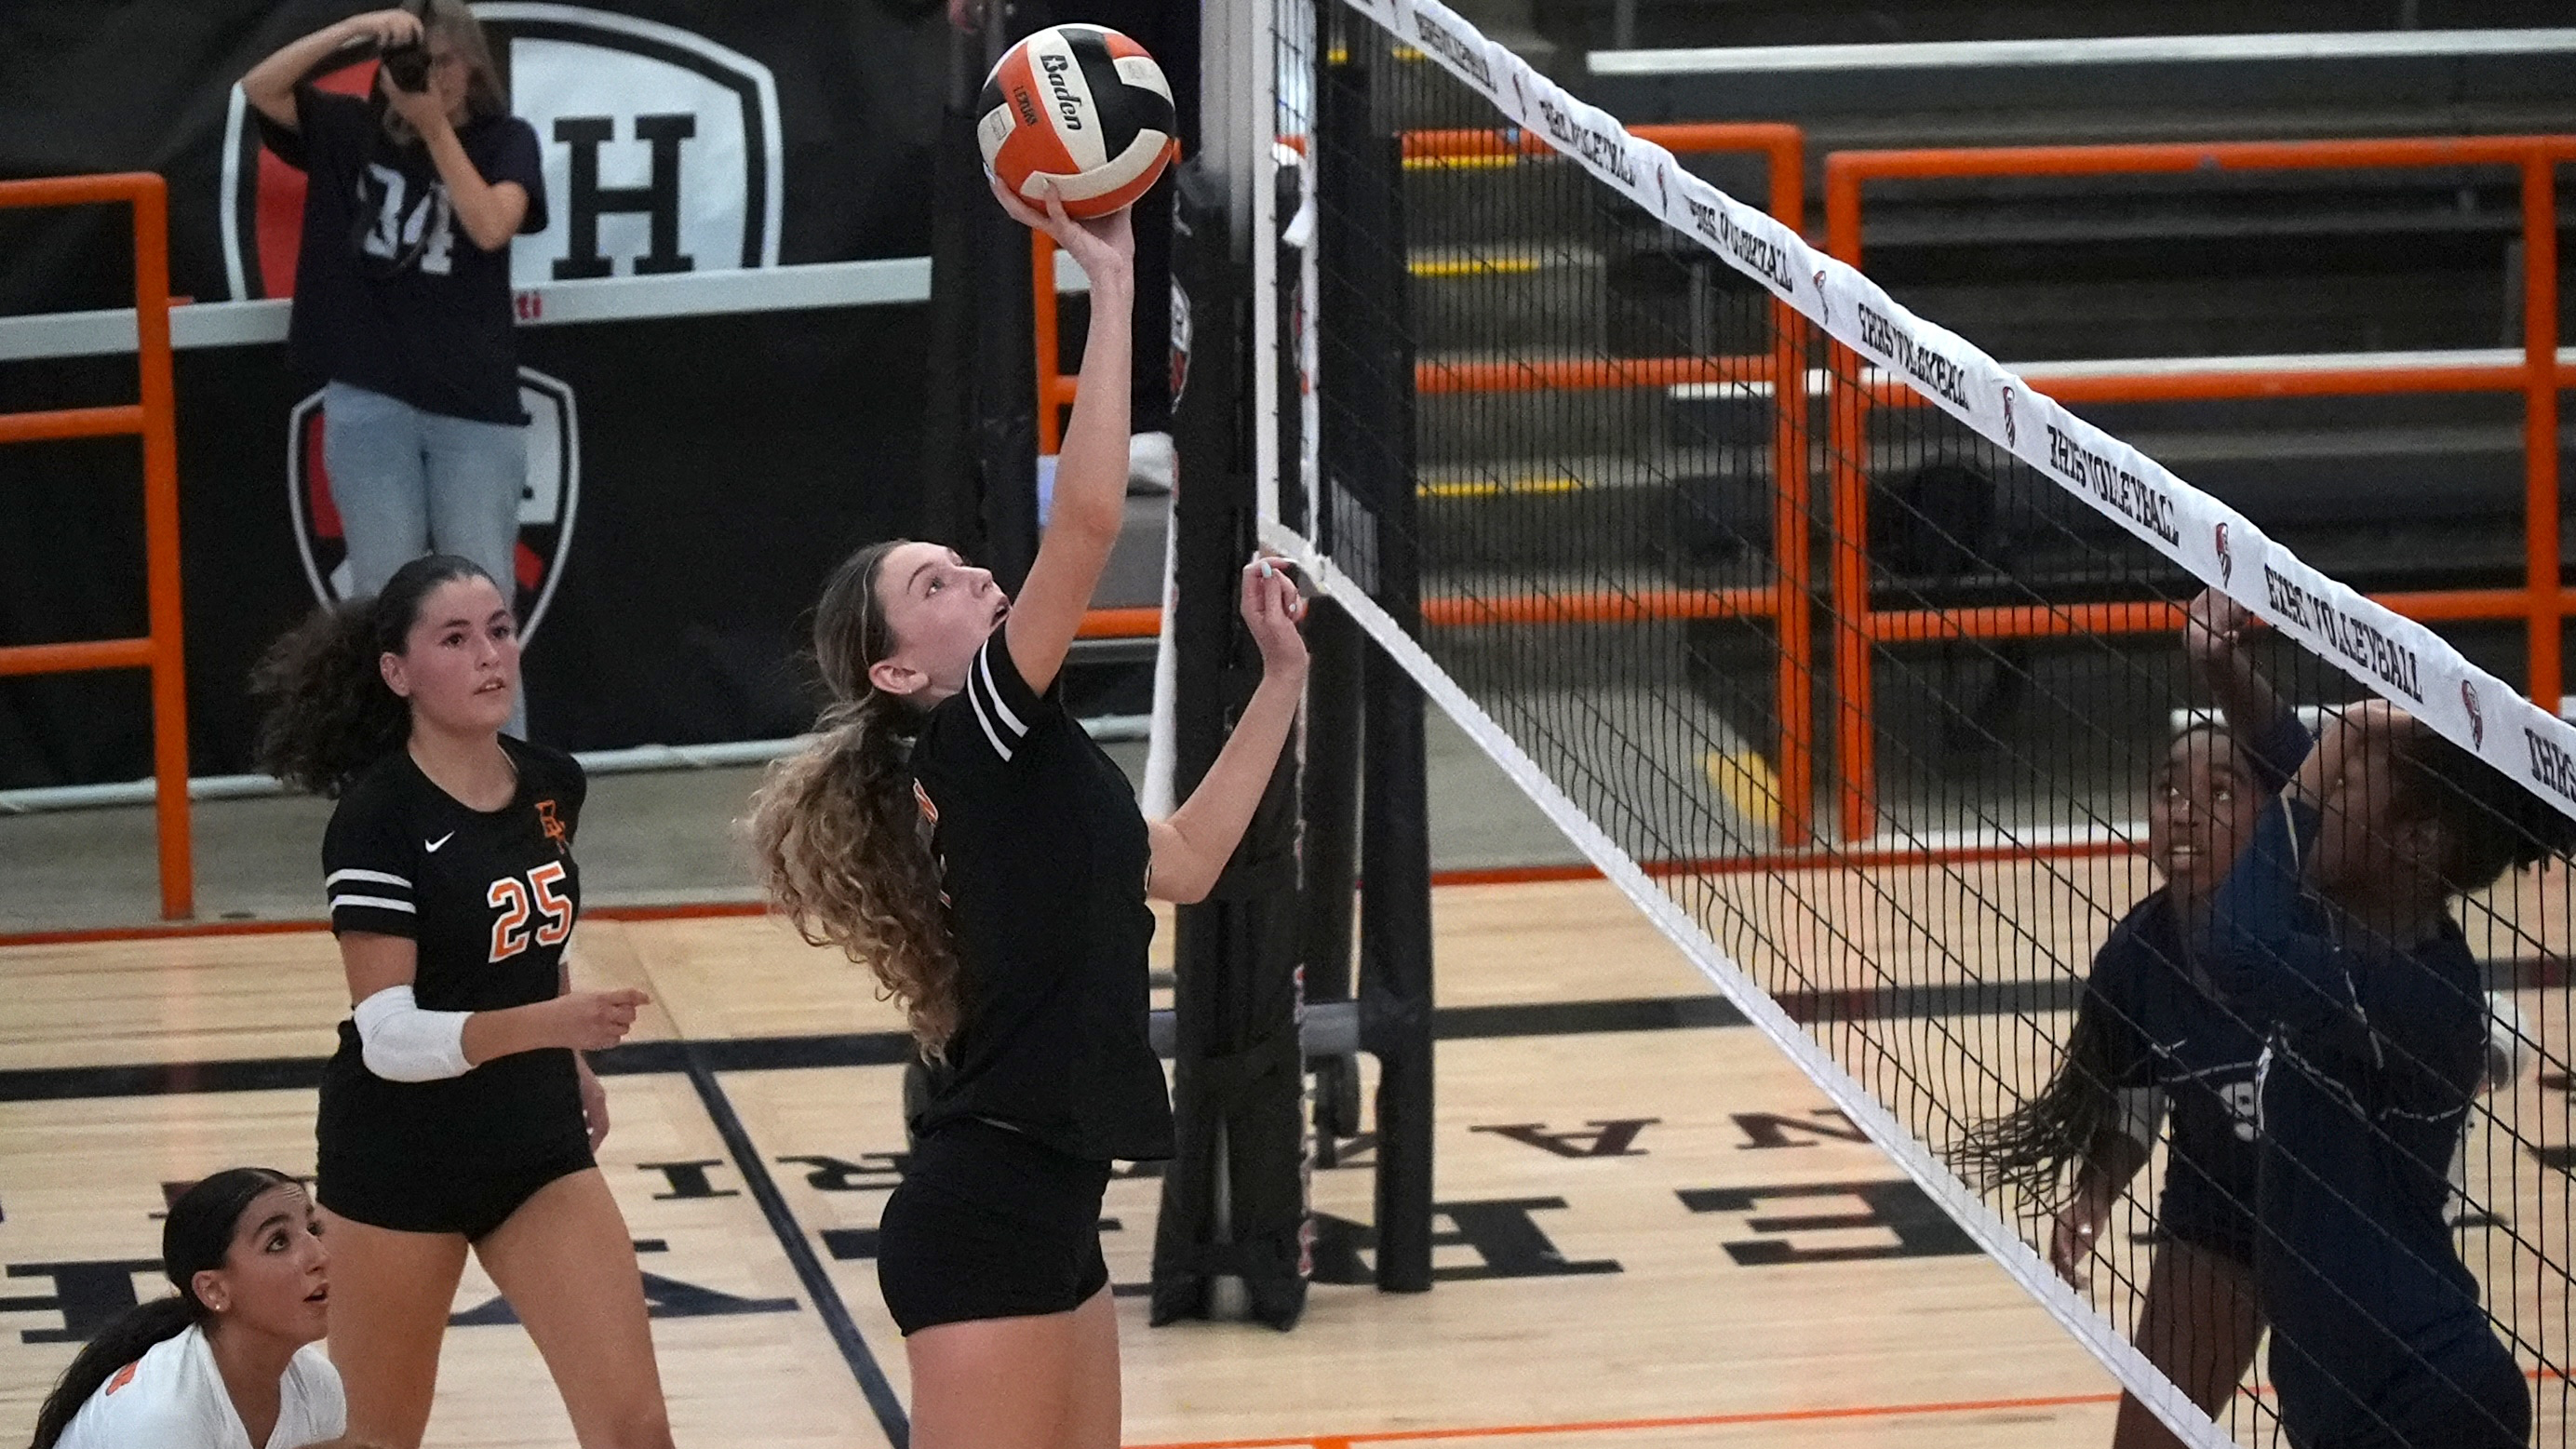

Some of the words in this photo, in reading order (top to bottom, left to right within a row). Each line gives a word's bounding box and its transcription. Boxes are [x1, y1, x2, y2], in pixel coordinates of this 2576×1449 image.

[1040, 55, 1082, 130] Baden
[552, 113, 696, 280] H
[2305, 592, 2423, 704] VOLLEYBALL
[487, 861, 572, 962] 25
